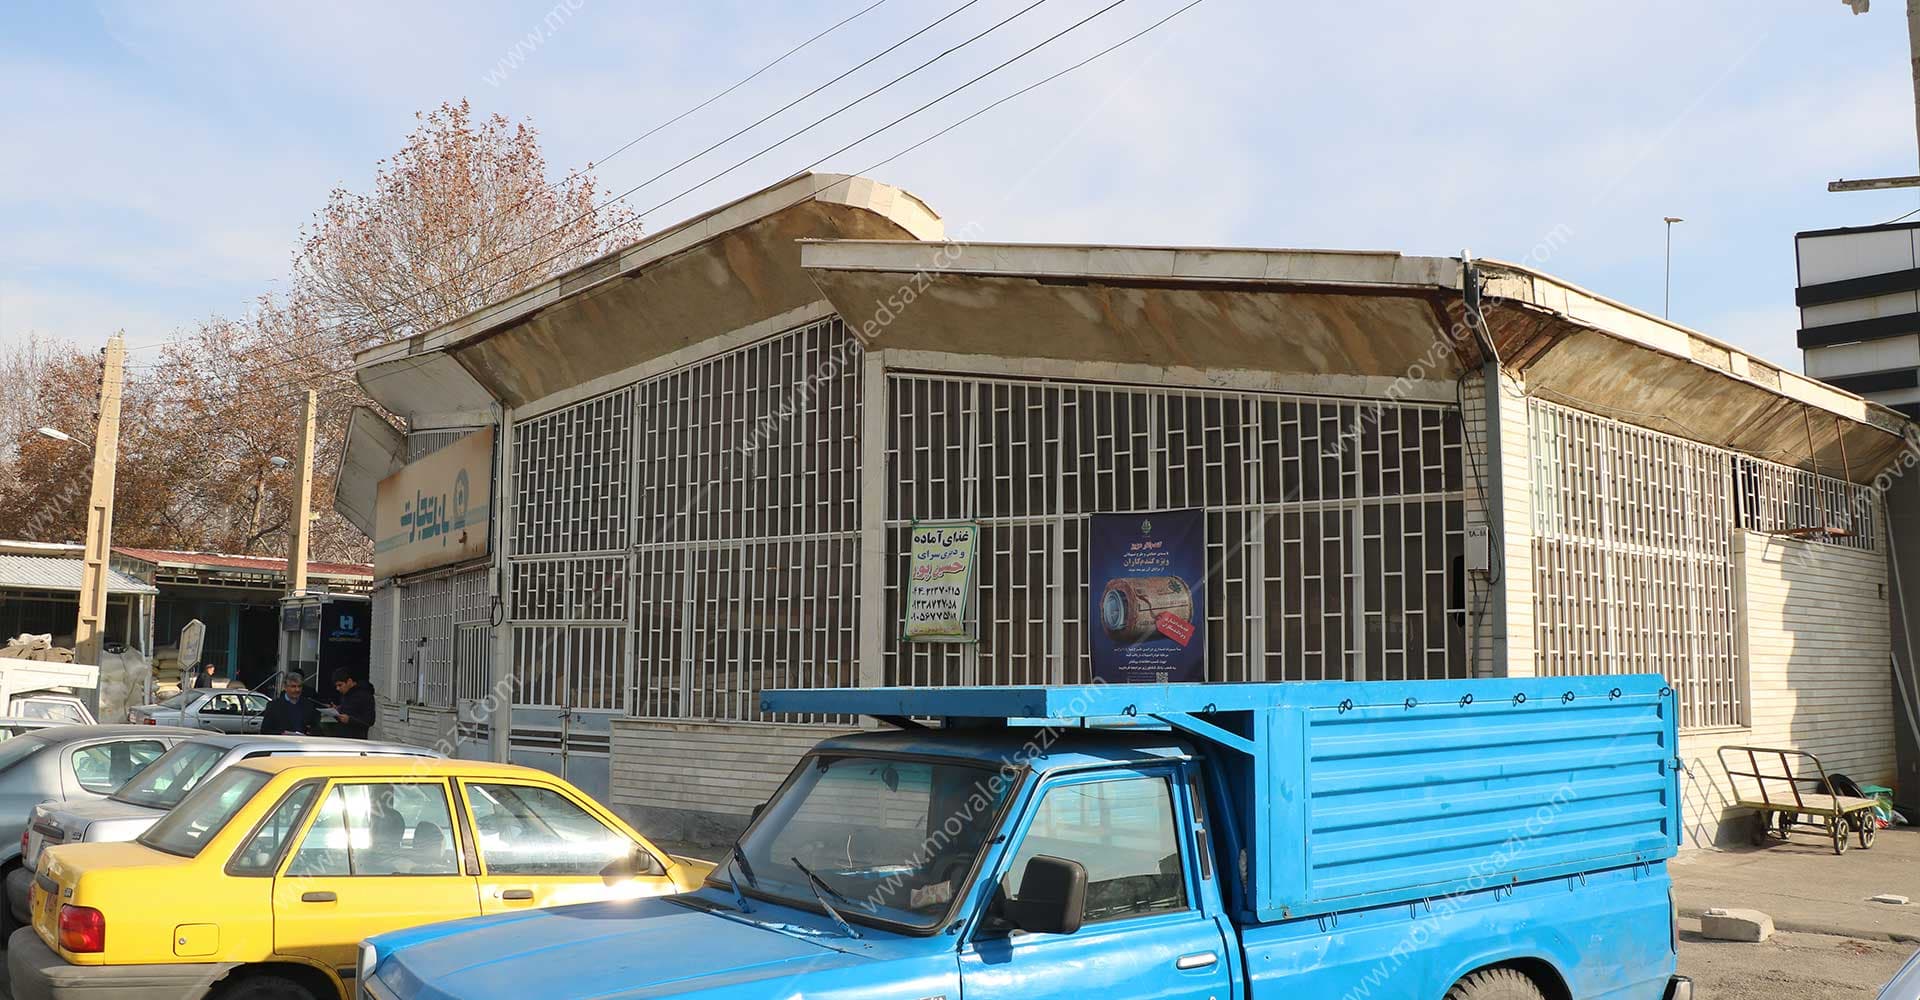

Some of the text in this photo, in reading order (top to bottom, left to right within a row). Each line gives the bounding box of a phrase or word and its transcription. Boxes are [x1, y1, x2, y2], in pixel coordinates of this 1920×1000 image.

[914, 529, 969, 547] غذای آماده
[917, 549, 940, 560] سرای
[959, 551, 965, 559] و
